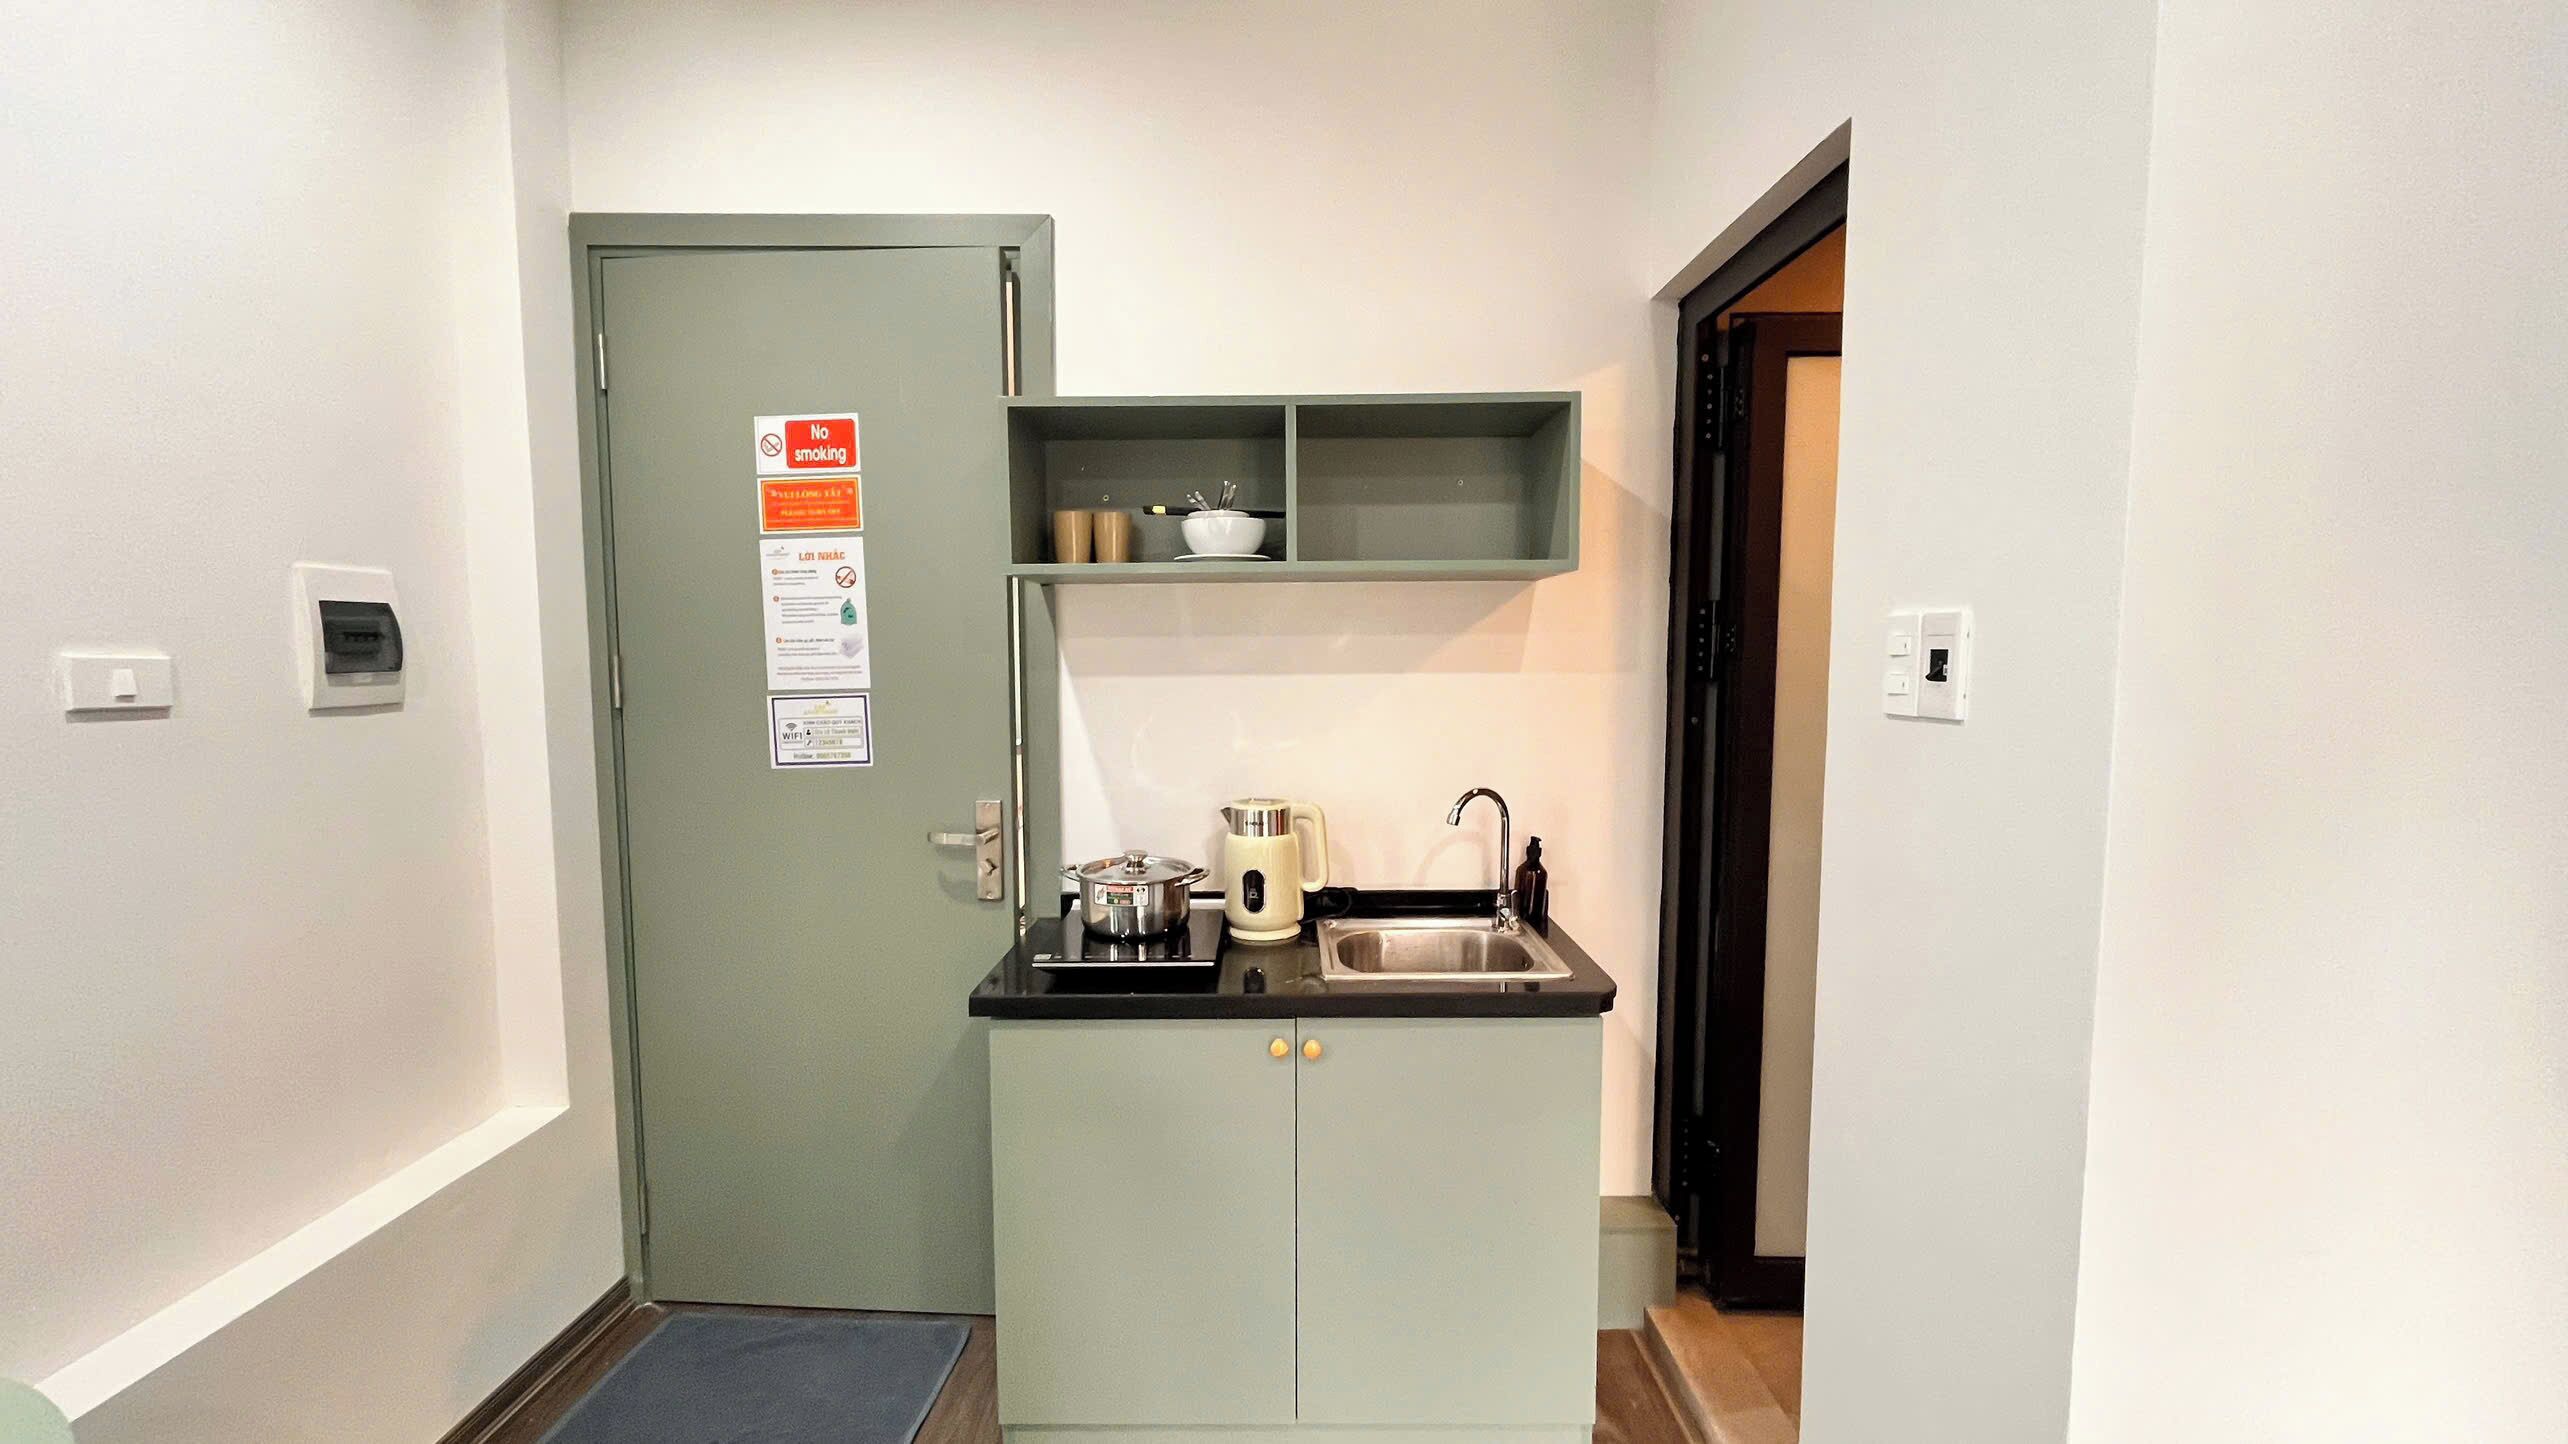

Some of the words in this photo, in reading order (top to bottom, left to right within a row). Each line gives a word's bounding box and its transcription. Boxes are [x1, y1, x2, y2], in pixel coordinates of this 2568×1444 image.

[810, 424, 829, 440] No
[794, 446, 847, 465] smoking
[782, 731, 803, 740] WIFI
